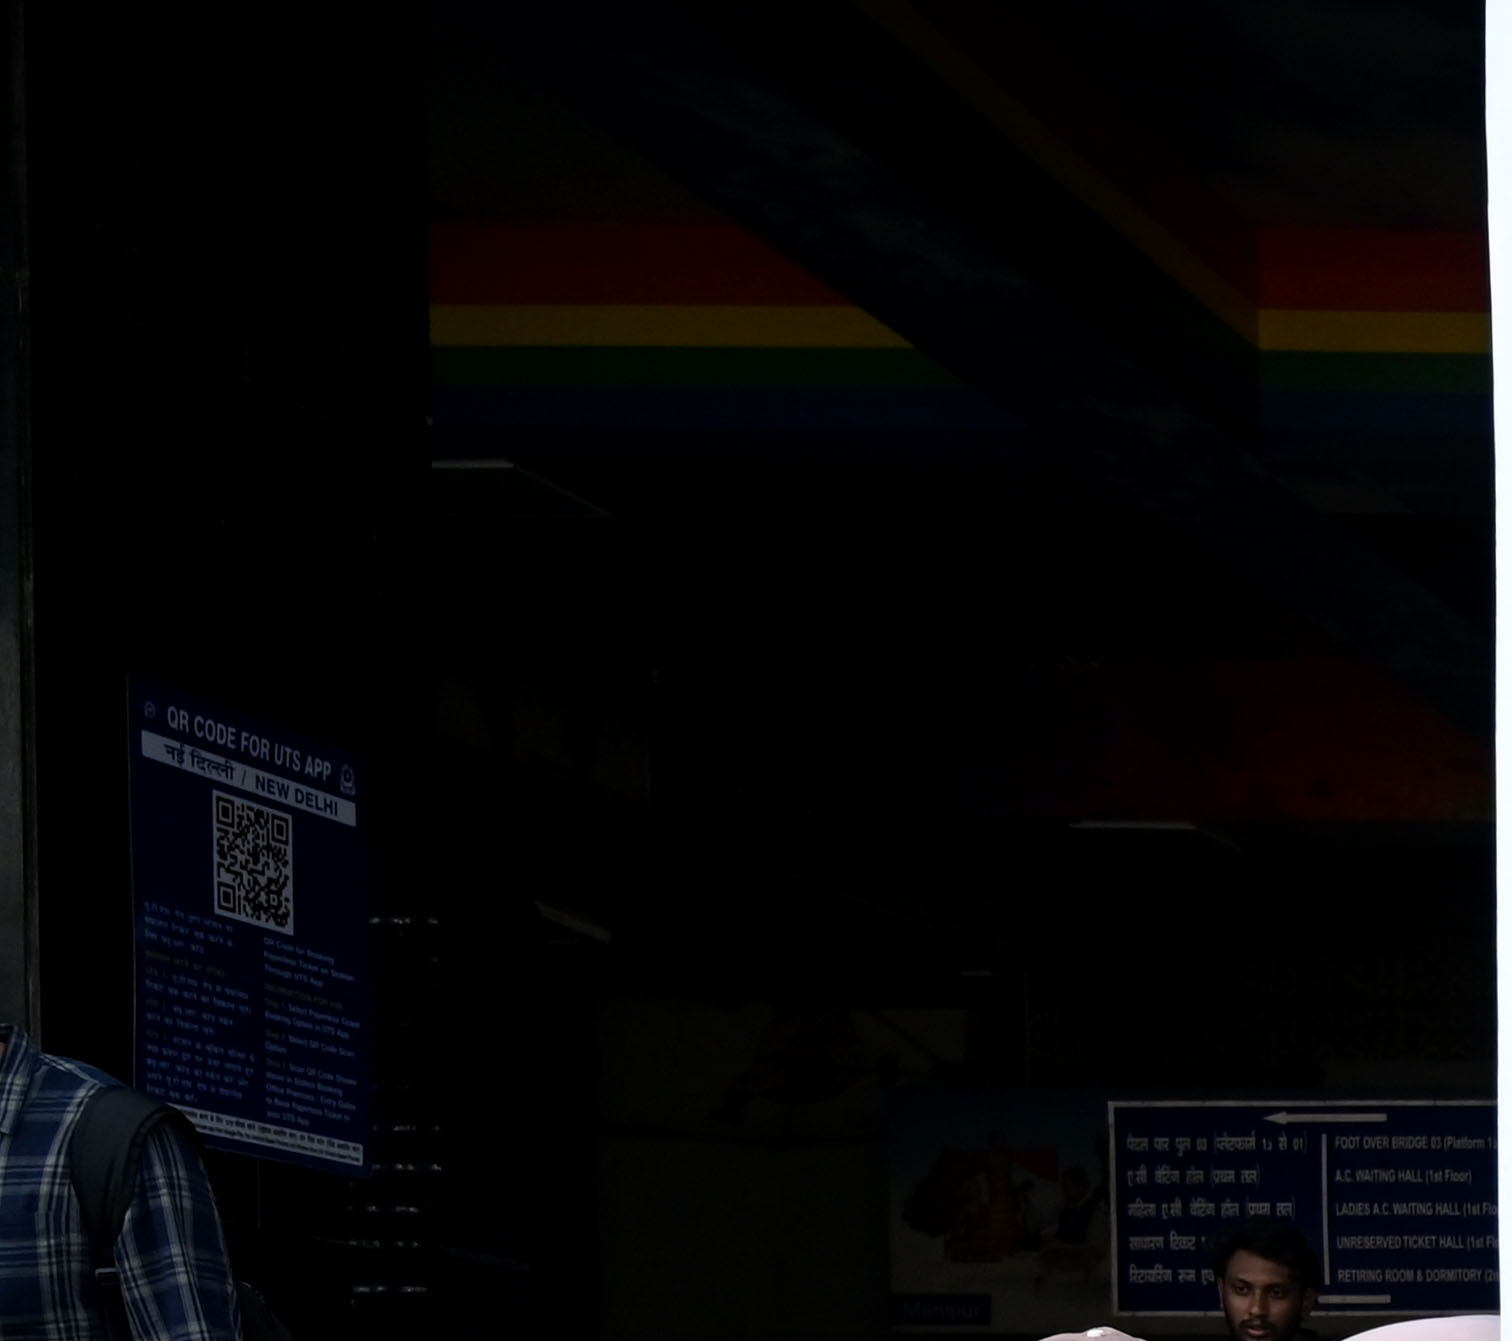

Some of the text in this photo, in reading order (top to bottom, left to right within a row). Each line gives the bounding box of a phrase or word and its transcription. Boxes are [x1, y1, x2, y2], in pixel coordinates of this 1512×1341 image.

[166, 704, 332, 782] QR CODE FOR UTS APP
[164, 741, 186, 764] नई
[190, 748, 235, 781] दिल्ली
[255, 774, 290, 801] NEW
[295, 787, 338, 817] DELHI
[1335, 1136, 1360, 1150] FOOT
[1363, 1136, 1390, 1150] OVER
[1391, 1136, 1428, 1150] BRIDGE
[1355, 1169, 1397, 1184] WAITING
[1398, 1169, 1424, 1184] HALL
[1444, 1168, 1473, 1185] Floor)
[1335, 1202, 1371, 1217] LADIES
[1392, 1202, 1434, 1217] WAITING
[1435, 1202, 1461, 1217] HALL
[1337, 1234, 1401, 1249] UNRESERVED
[1402, 1234, 1437, 1249] TICKET
[1439, 1234, 1465, 1249] HALL
[1338, 1267, 1383, 1283] RETIRING
[1384, 1268, 1415, 1283] ROOM
[1416, 1268, 1425, 1283] &
[1426, 1268, 1482, 1283] DORMITORY
